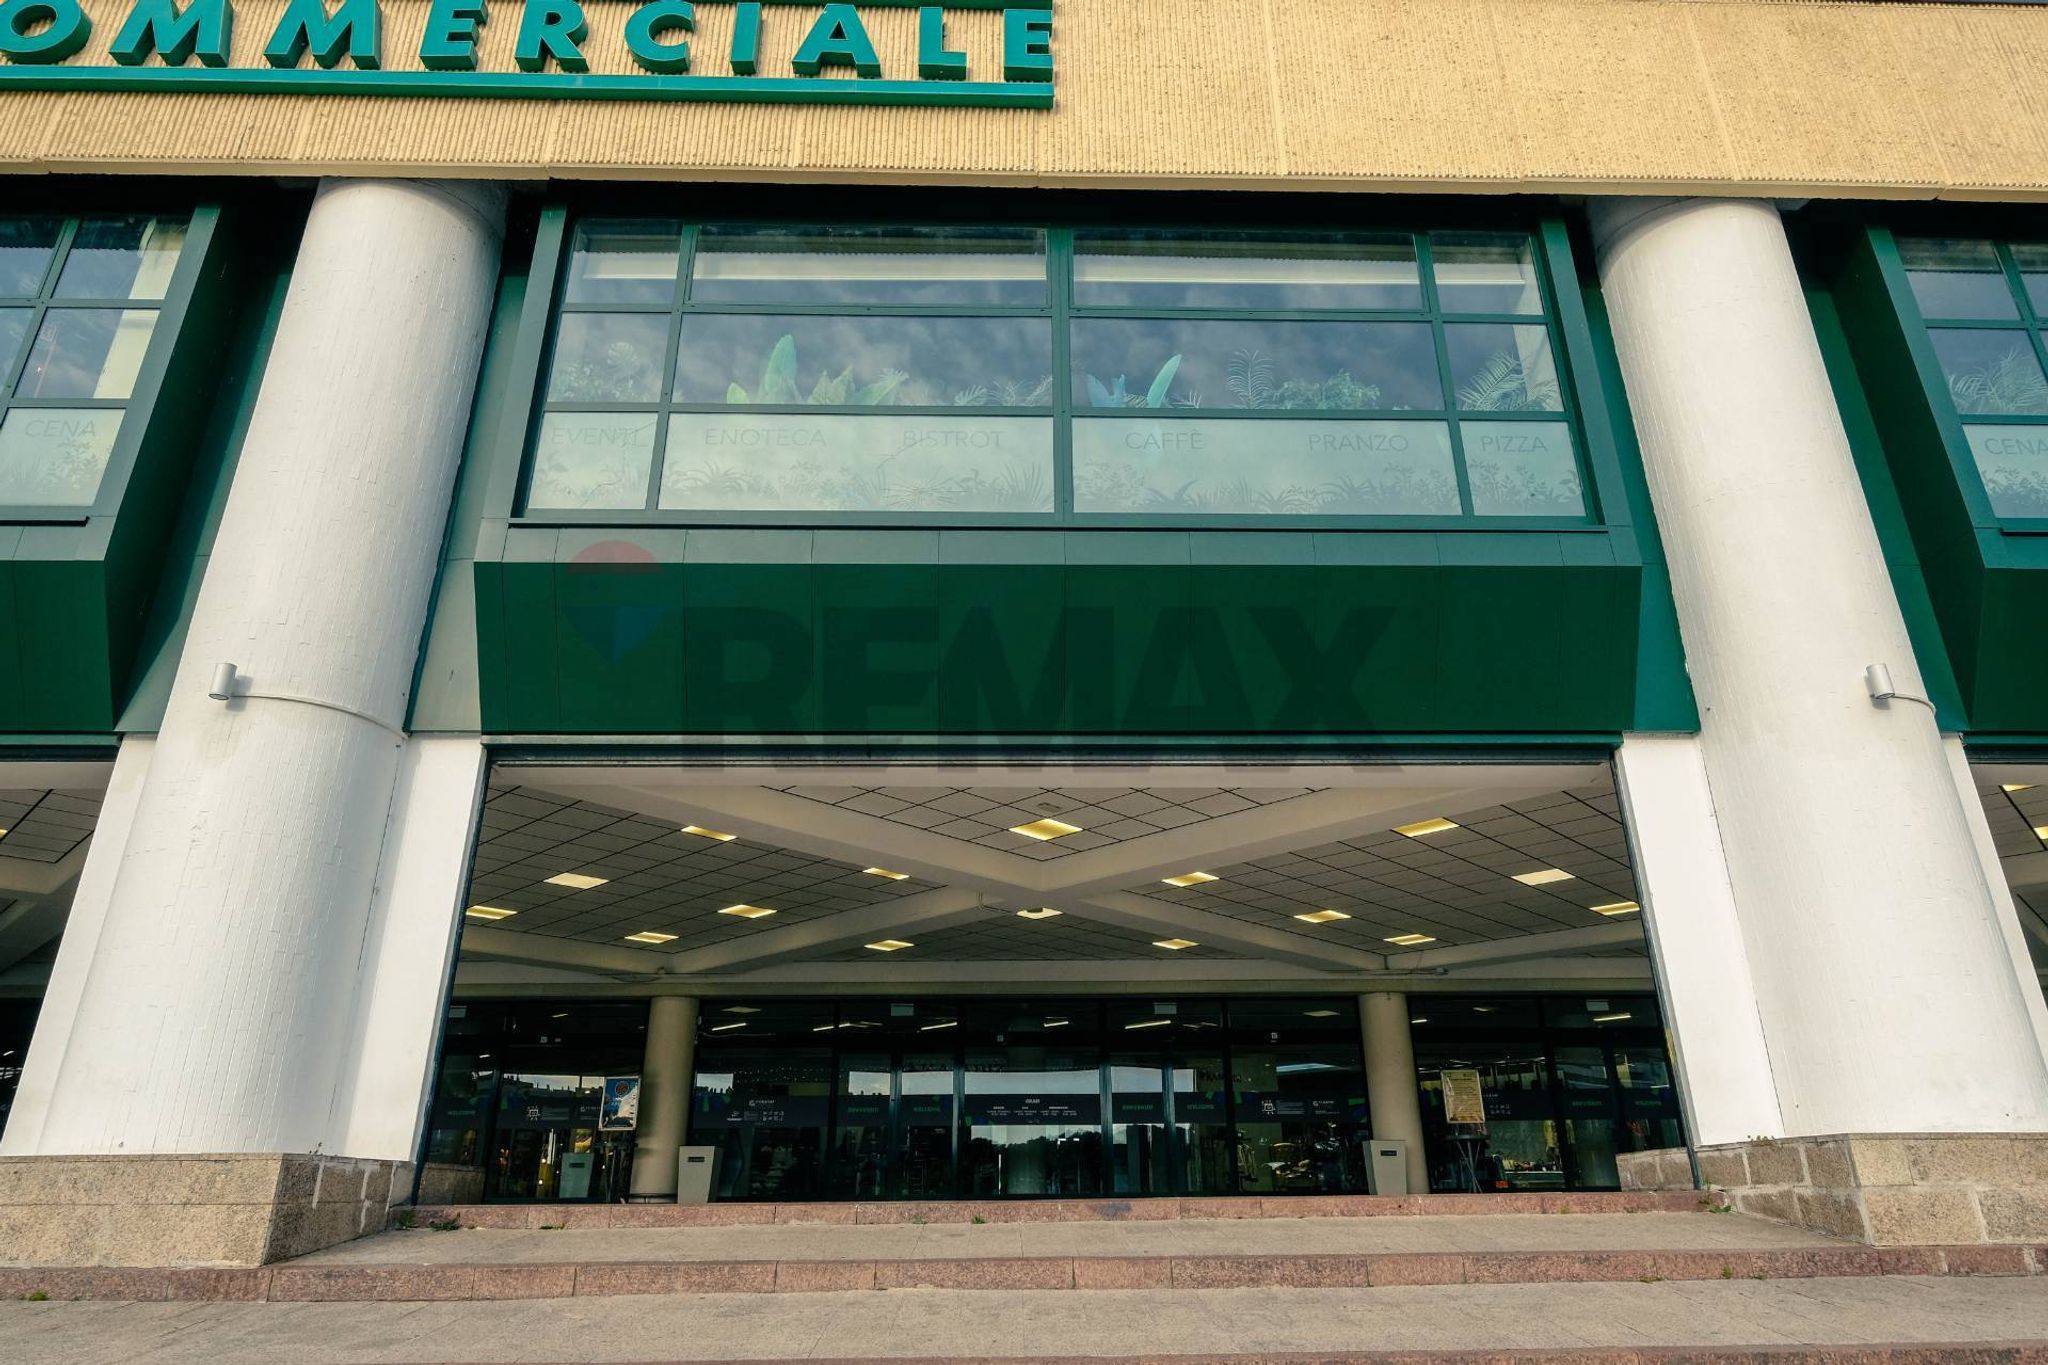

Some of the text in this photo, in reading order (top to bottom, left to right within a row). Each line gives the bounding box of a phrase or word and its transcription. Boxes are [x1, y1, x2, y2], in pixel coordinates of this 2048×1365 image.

[25, 419, 97, 438] CENA
[705, 428, 826, 446] ENOTECA
[904, 430, 1003, 450] BISTROT
[1308, 433, 1409, 453] PRANZO
[1480, 434, 1548, 453] PIZZA
